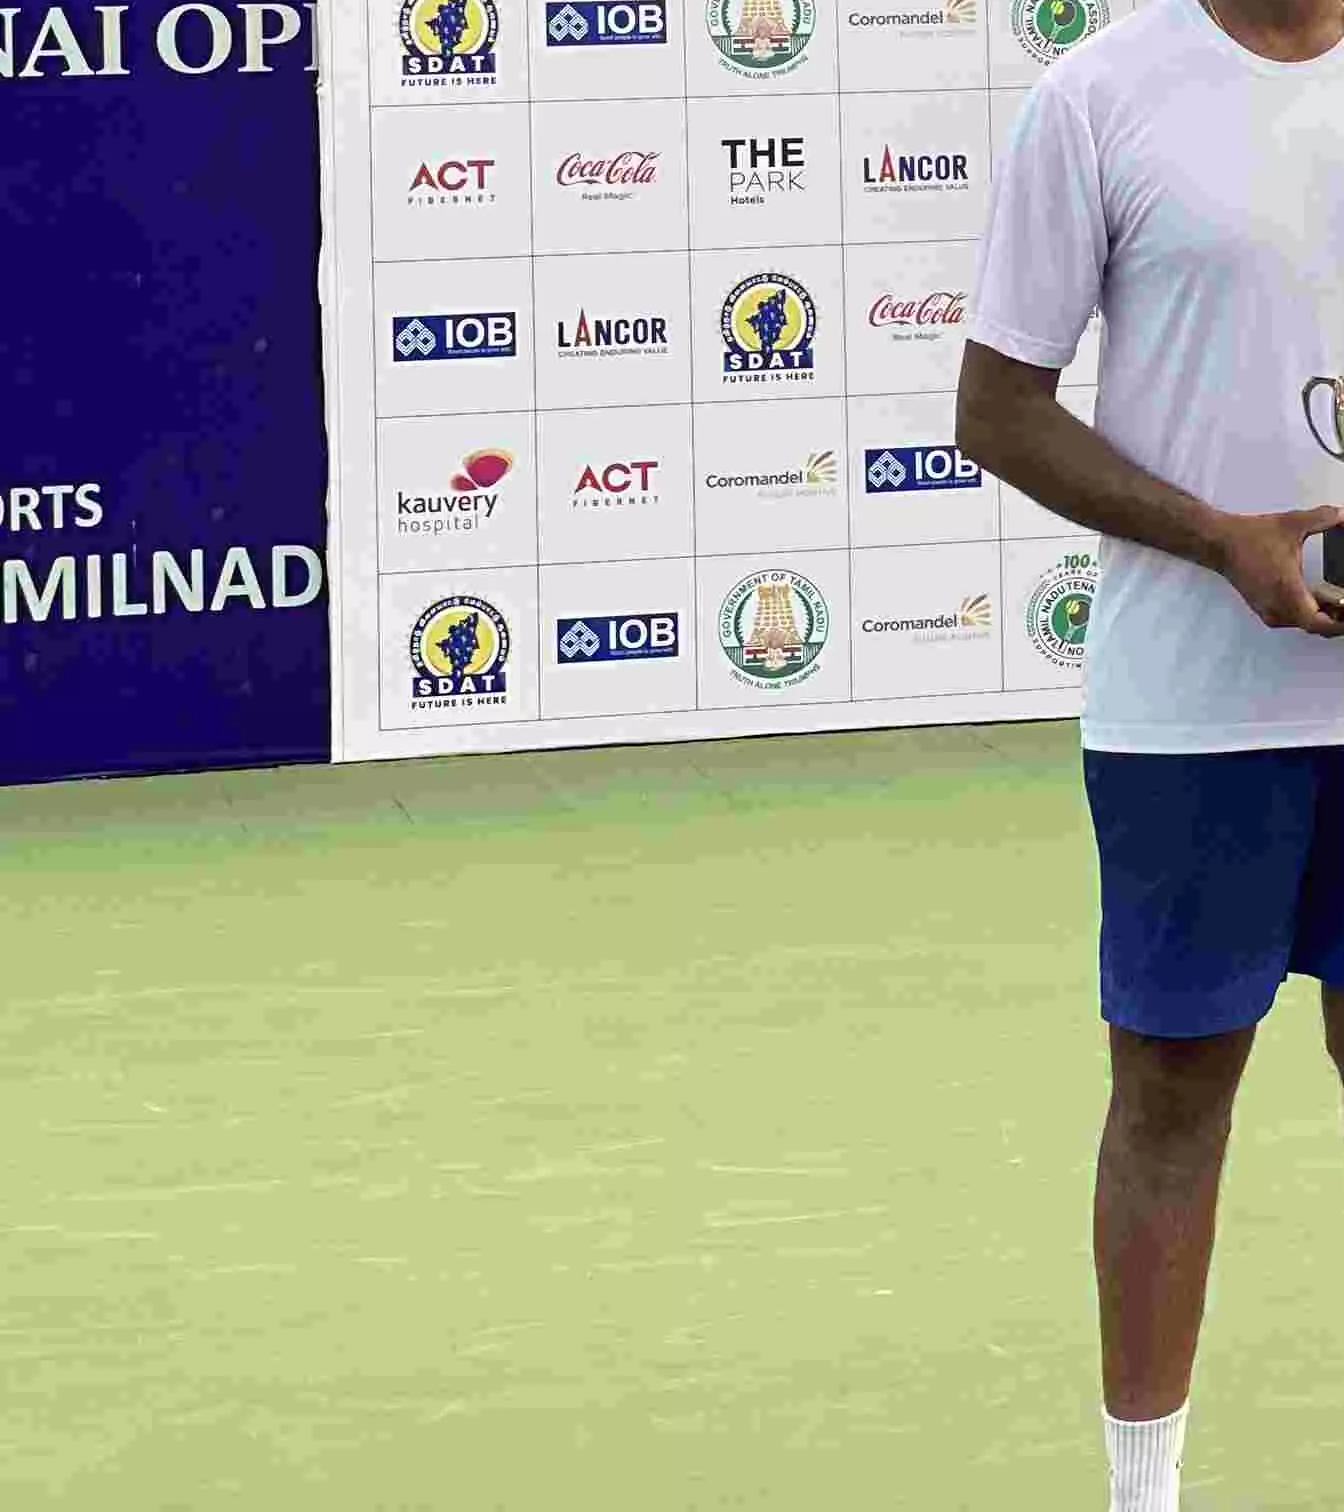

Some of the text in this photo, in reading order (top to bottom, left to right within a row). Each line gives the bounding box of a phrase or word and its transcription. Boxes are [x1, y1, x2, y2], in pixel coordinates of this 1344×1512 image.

[597, 5, 664, 35] IOB
[848, 11, 944, 27] Coromandel
[408, 56, 484, 74] SDAT
[401, 77, 496, 87] FUTURE IS HERE
[721, 138, 804, 168] THE
[864, 144, 968, 183] LANCOR
[409, 160, 495, 191] ACT
[557, 151, 662, 186] Coca-Cola
[730, 171, 805, 193] PARK
[731, 196, 764, 205] Hotels
[869, 292, 967, 328] Coca-Cola
[445, 317, 512, 348] IOB
[558, 308, 667, 348] LANCOR
[729, 352, 801, 369] SDAT
[723, 372, 814, 384] FUTURE IS HERE
[575, 461, 658, 494] ACT
[915, 450, 979, 480] IOB
[705, 471, 802, 488] Coromandel
[0, 484, 102, 532] RTS
[399, 492, 498, 518] kauvery
[399, 515, 479, 535] hospital
[1063, 554, 1091, 570] 100
[724, 574, 768, 638] GOVERNMENT
[1041, 586, 1066, 622] NADU
[608, 618, 676, 650] IOB
[861, 614, 958, 633] Coromandel
[1039, 624, 1062, 652] TAMIL
[418, 675, 495, 696] SDAT
[411, 696, 507, 710] FUTURE IS HERE
